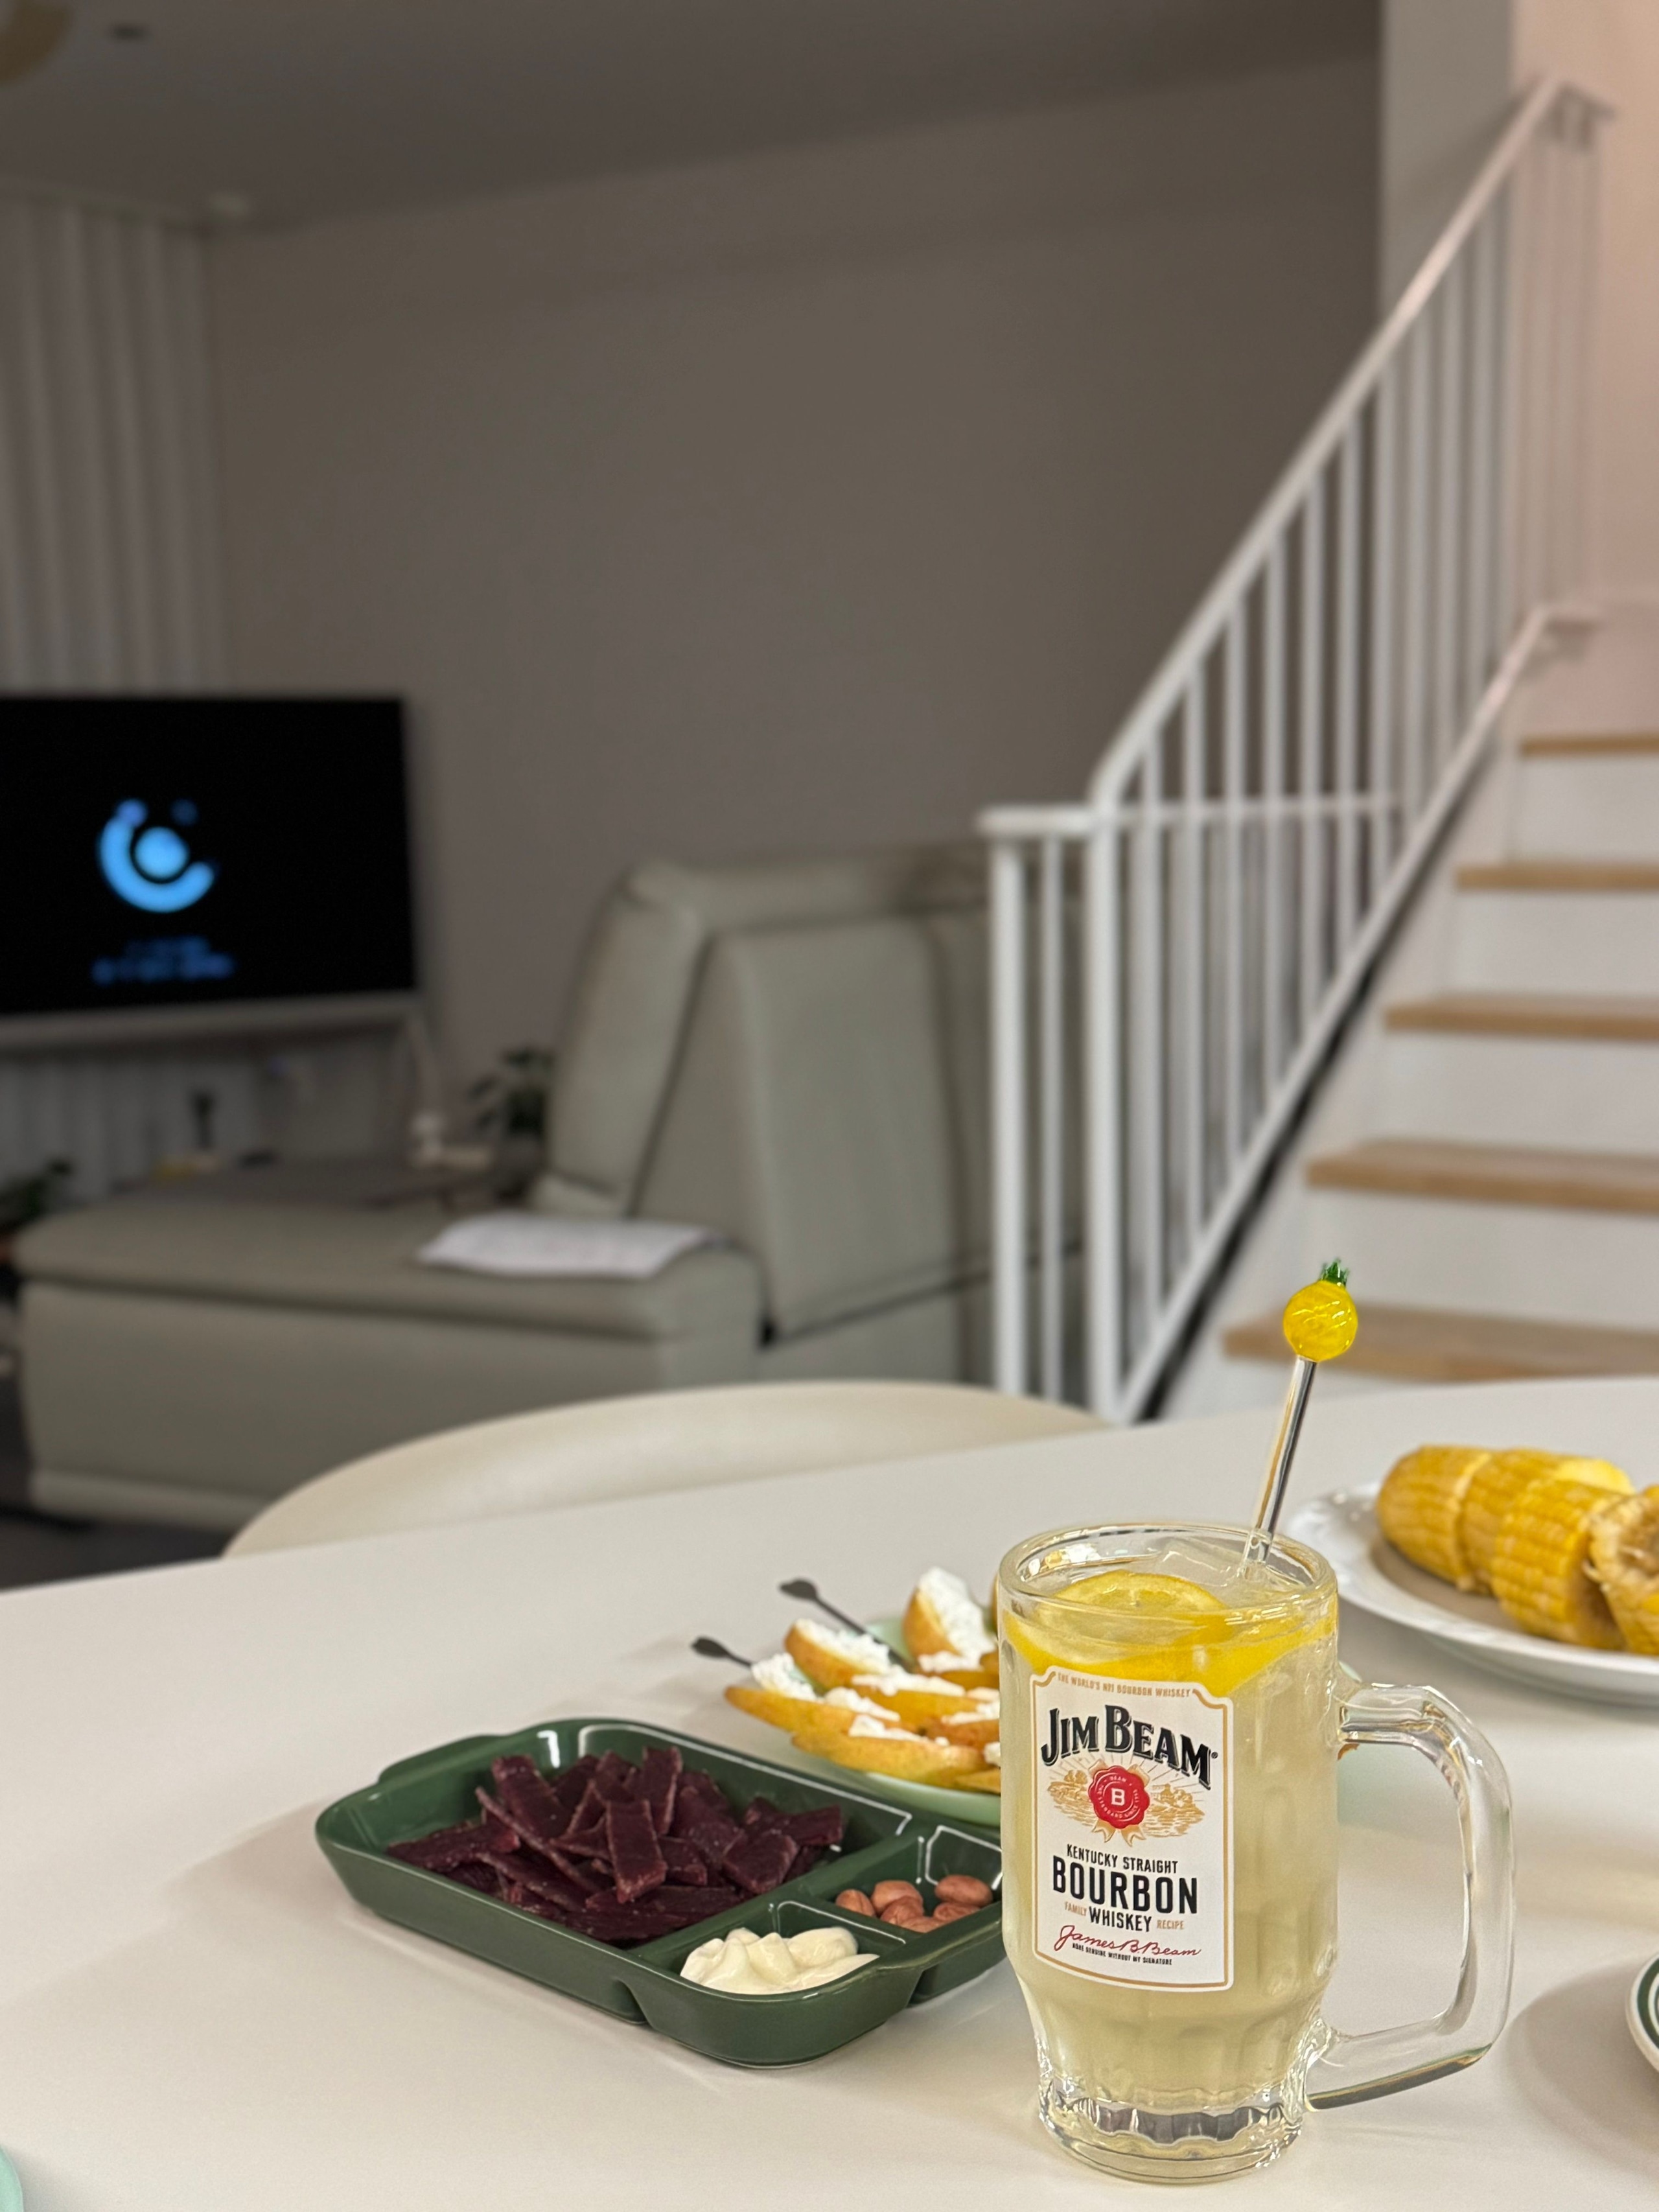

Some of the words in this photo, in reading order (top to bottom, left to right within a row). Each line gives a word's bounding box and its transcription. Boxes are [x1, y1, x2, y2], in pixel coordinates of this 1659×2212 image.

[1058, 1673, 1069, 1684] THE
[1117, 1684, 1152, 1696] BOURBON
[1155, 1688, 1190, 1697] WHISKEY
[1041, 1708, 1100, 1766] JIM
[1111, 1788, 1125, 1806] B
[1067, 1844, 1118, 1868] KENTUCKY
[1123, 1856, 1178, 1874] STRAIGHT
[1053, 1855, 1198, 1915] BOURBON
[1064, 1902, 1087, 1916] FAMILY
[1089, 1906, 1152, 1932] WHISKEY
[1156, 1920, 1184, 1930] RECIPE
[1054, 1925, 1116, 1951] James
